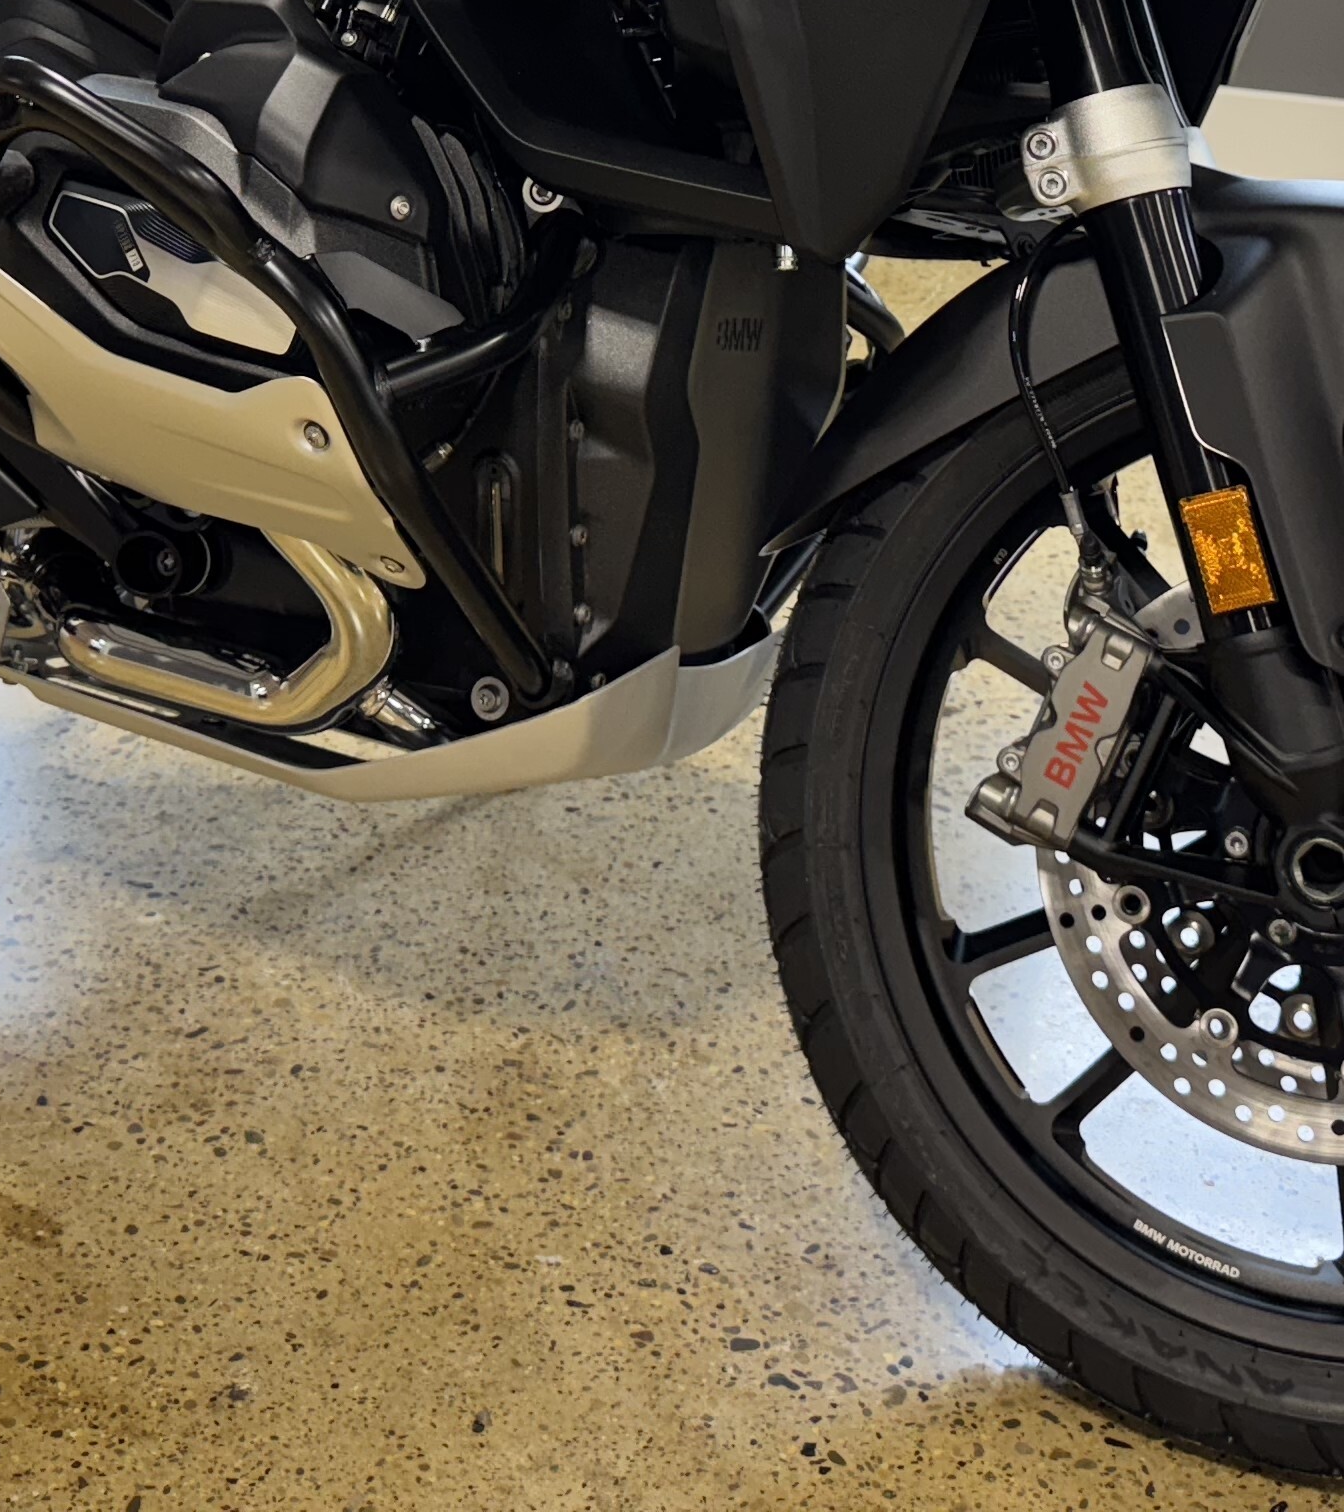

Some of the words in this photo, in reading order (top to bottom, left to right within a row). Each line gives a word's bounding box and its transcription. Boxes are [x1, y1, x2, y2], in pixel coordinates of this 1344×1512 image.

[717, 317, 764, 352] BMW
[1043, 680, 1109, 790] BMW
[1133, 1218, 1167, 1246] BMW
[1166, 1239, 1240, 1278] MOTORRAD
